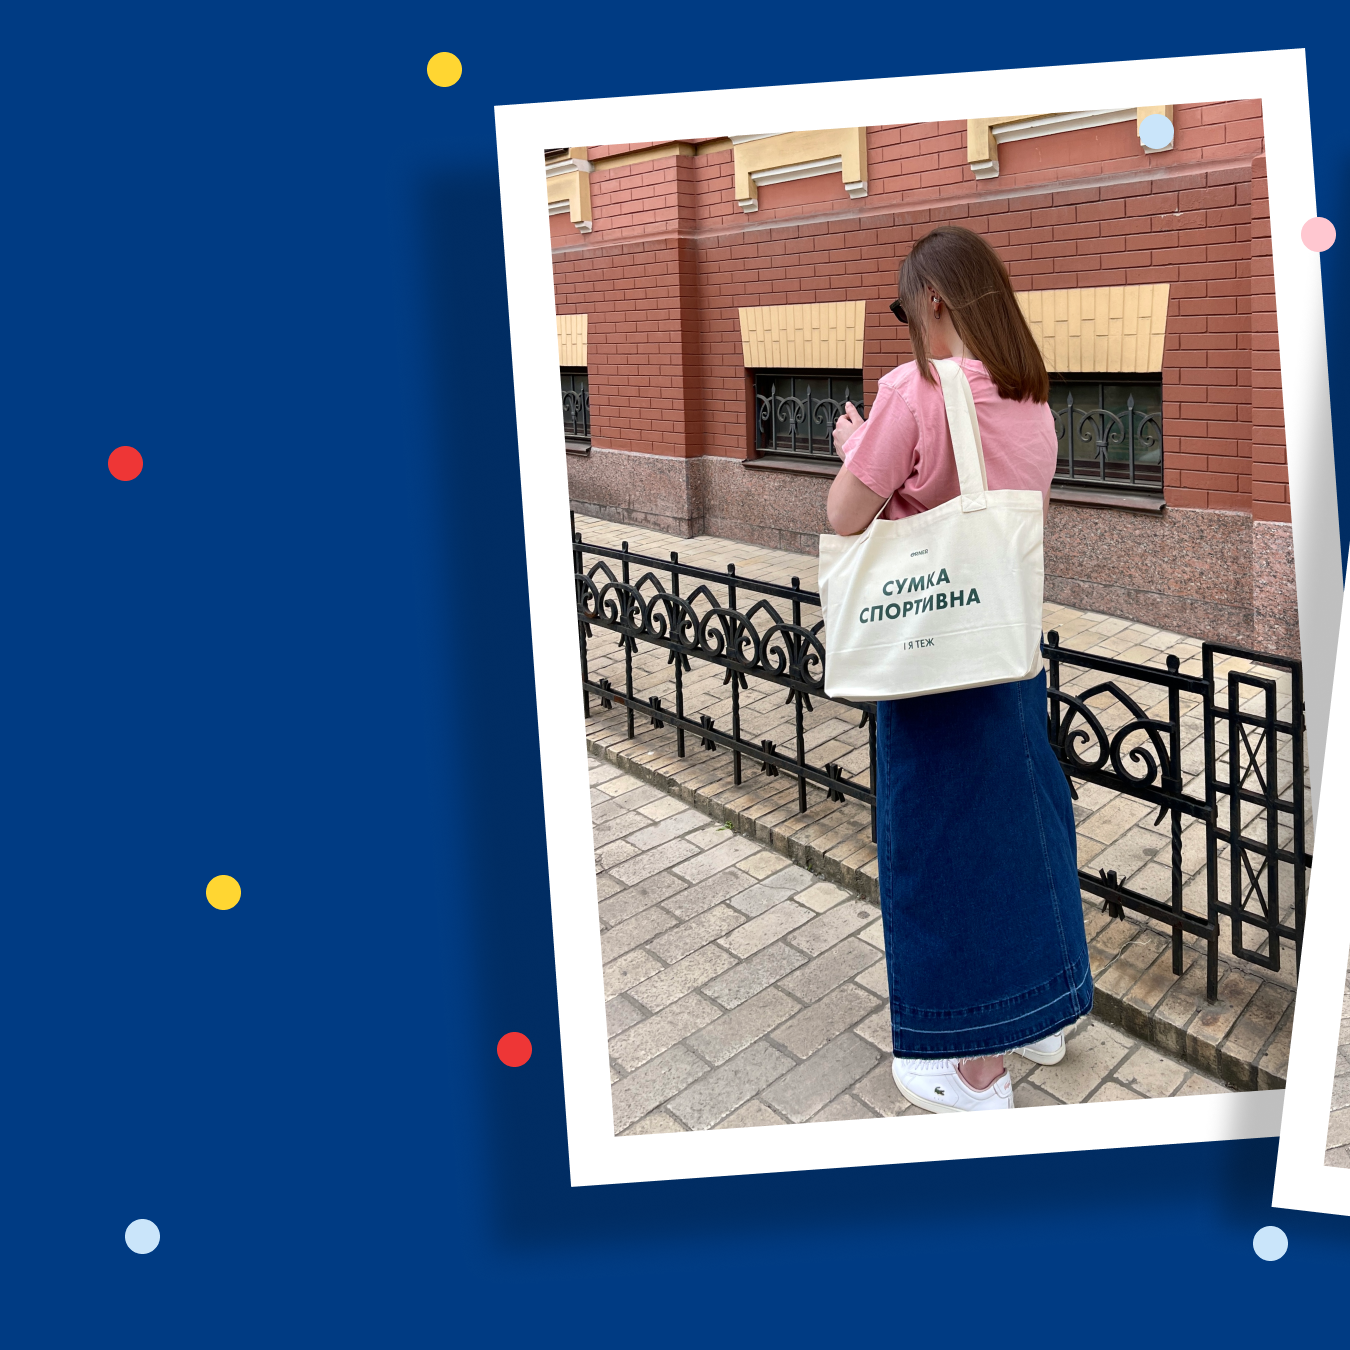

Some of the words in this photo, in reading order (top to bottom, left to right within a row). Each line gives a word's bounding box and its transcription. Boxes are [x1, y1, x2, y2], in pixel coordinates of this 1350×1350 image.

[882, 568, 950, 596] СУМКА
[859, 588, 981, 624] СПОРТИВНА
[908, 640, 914, 649] Я
[916, 638, 935, 649] ТЕЖ
